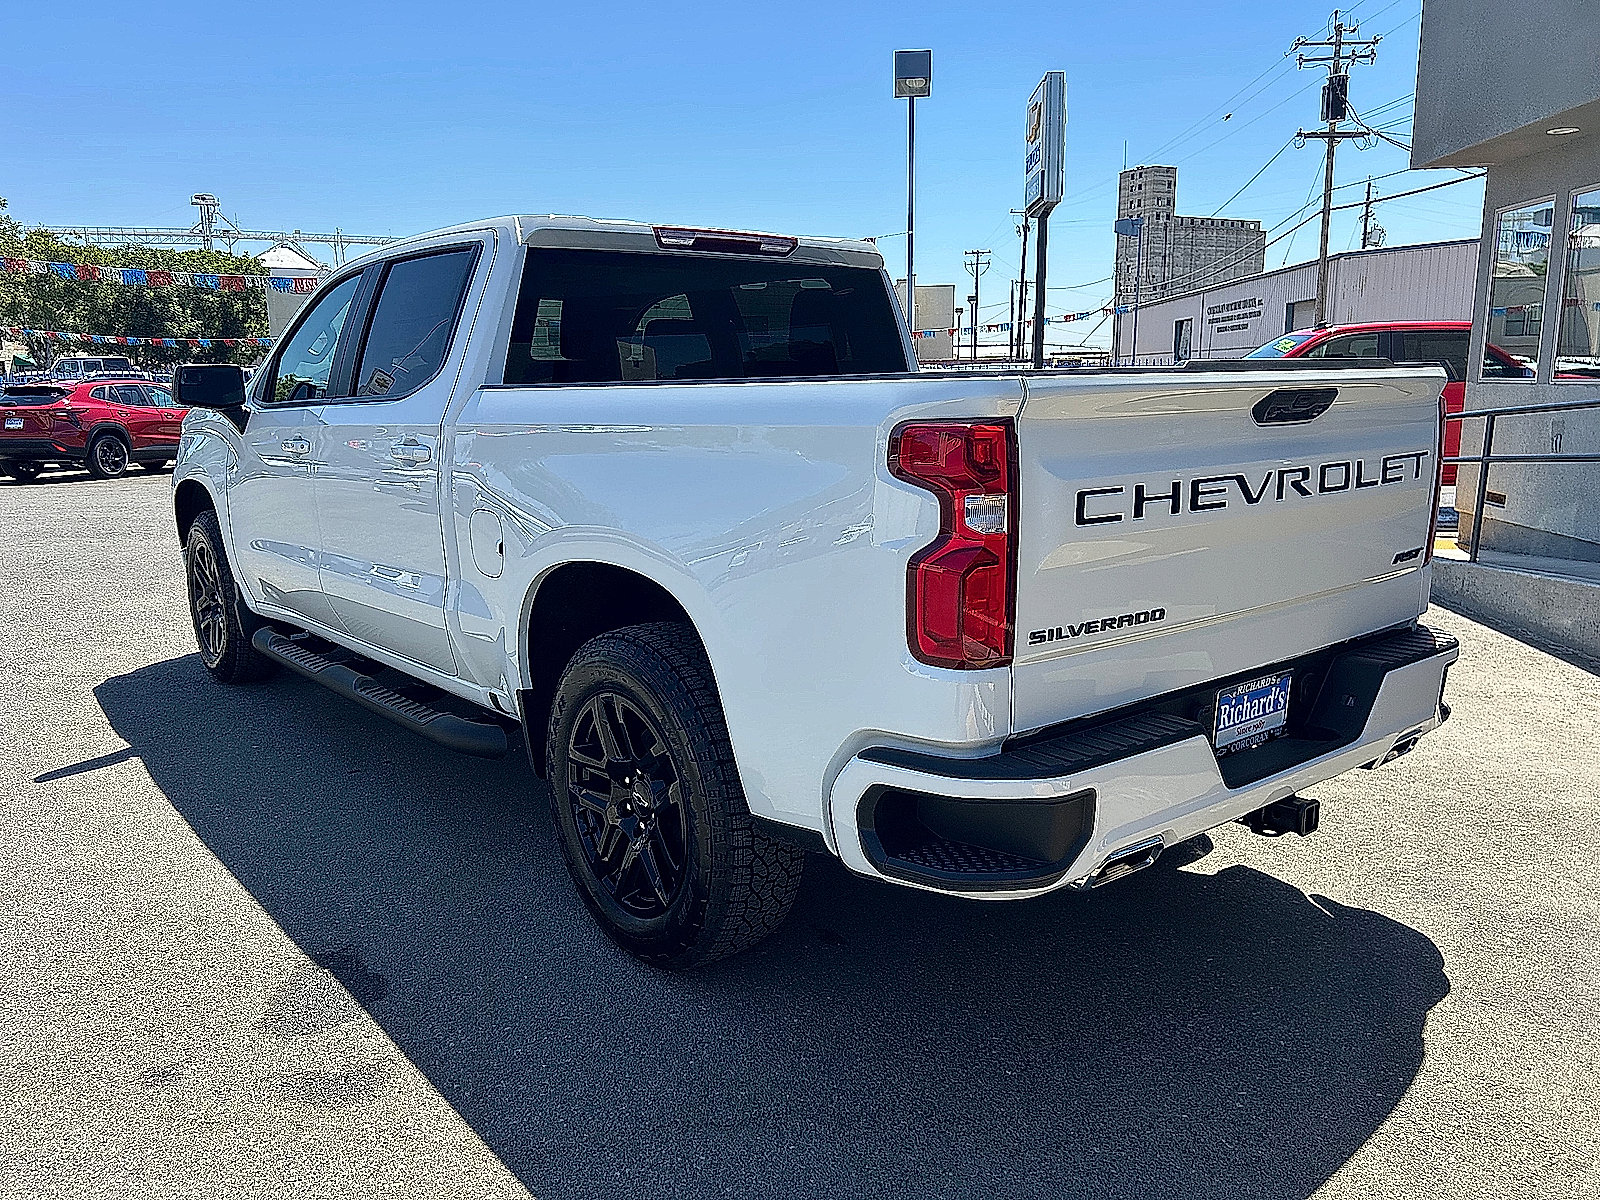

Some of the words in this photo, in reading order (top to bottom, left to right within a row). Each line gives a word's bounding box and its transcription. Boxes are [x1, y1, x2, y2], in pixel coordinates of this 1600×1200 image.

[1075, 450, 1429, 527] CHEVROLET
[1028, 607, 1166, 645] SILVERADO
[1218, 687, 1285, 729] Richard's
[1236, 724, 1253, 737] Since
